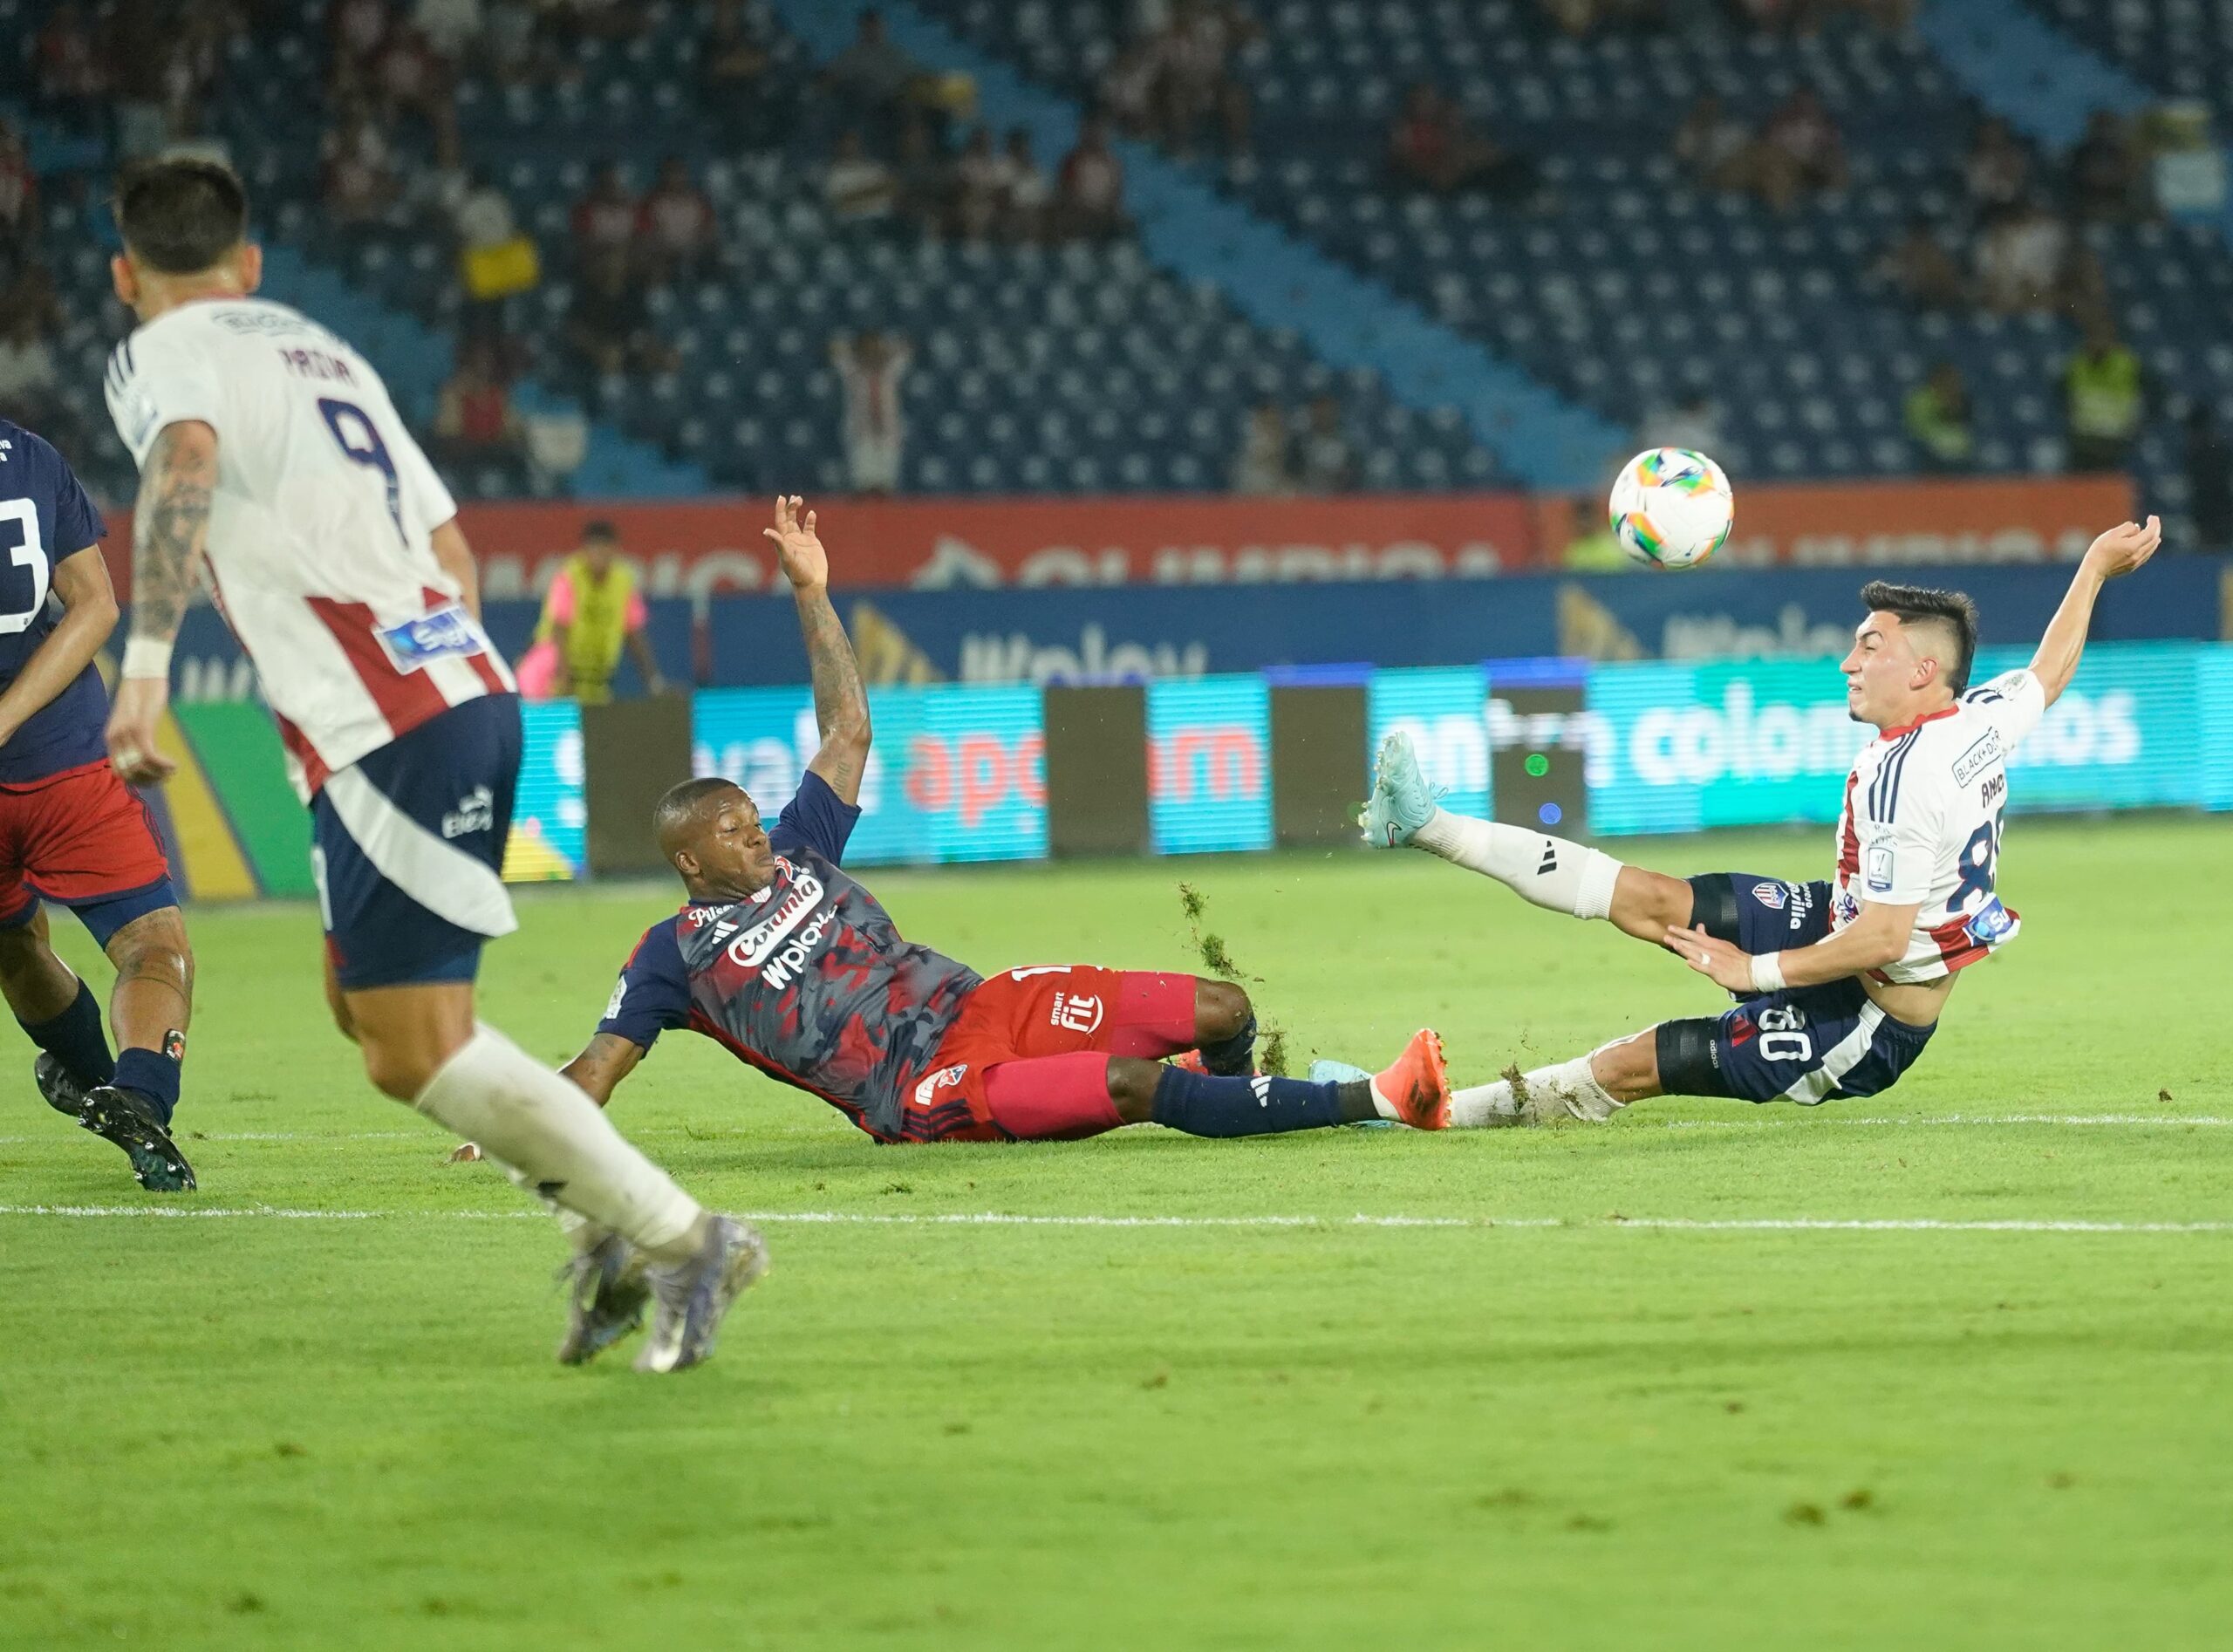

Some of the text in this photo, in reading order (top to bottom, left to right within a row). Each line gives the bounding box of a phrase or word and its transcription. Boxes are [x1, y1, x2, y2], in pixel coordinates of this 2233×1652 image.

[318, 398, 410, 550] 9
[0, 498, 49, 633] 3
[1050, 991, 1065, 1027] smart
